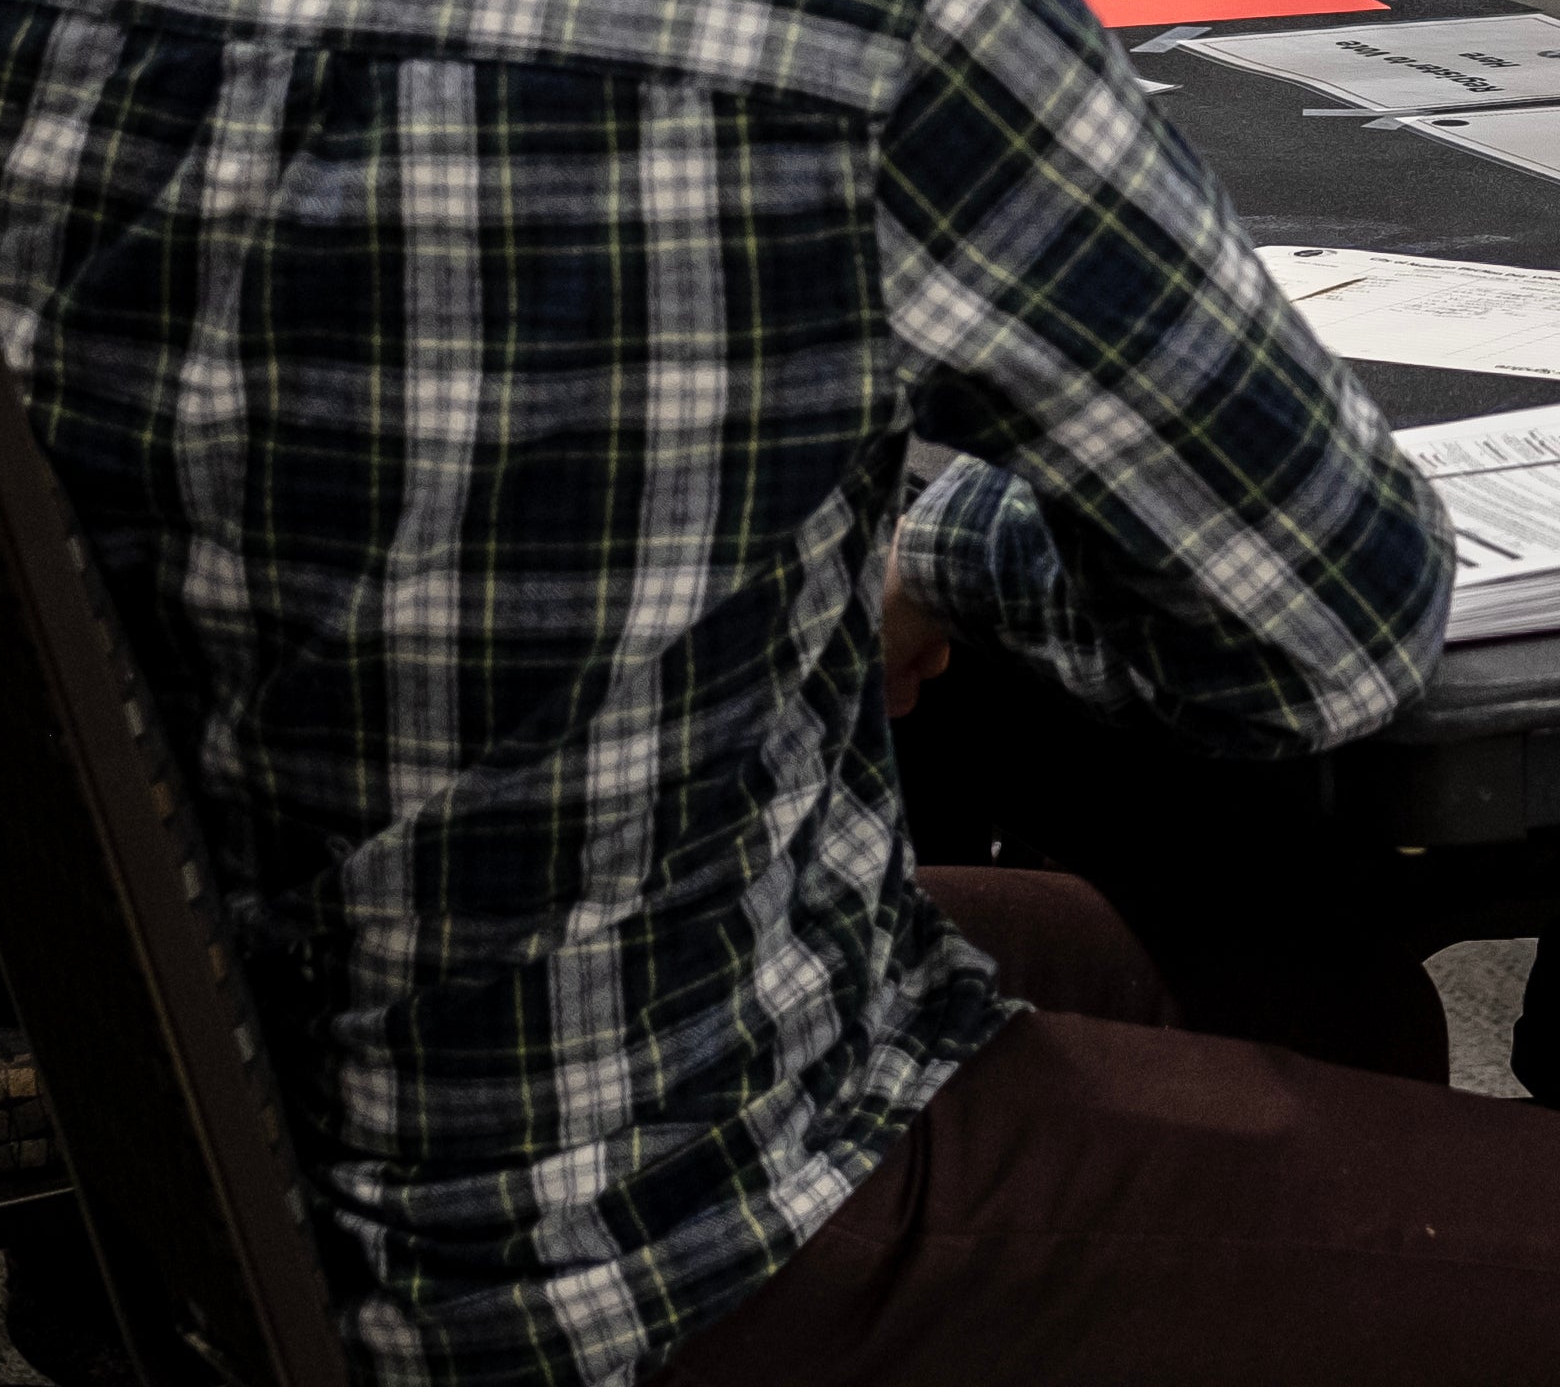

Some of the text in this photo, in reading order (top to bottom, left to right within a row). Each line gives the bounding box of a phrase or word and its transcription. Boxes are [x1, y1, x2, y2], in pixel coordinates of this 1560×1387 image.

[1336, 40, 1505, 93] Register to Vote
[1458, 52, 1521, 68] Here
